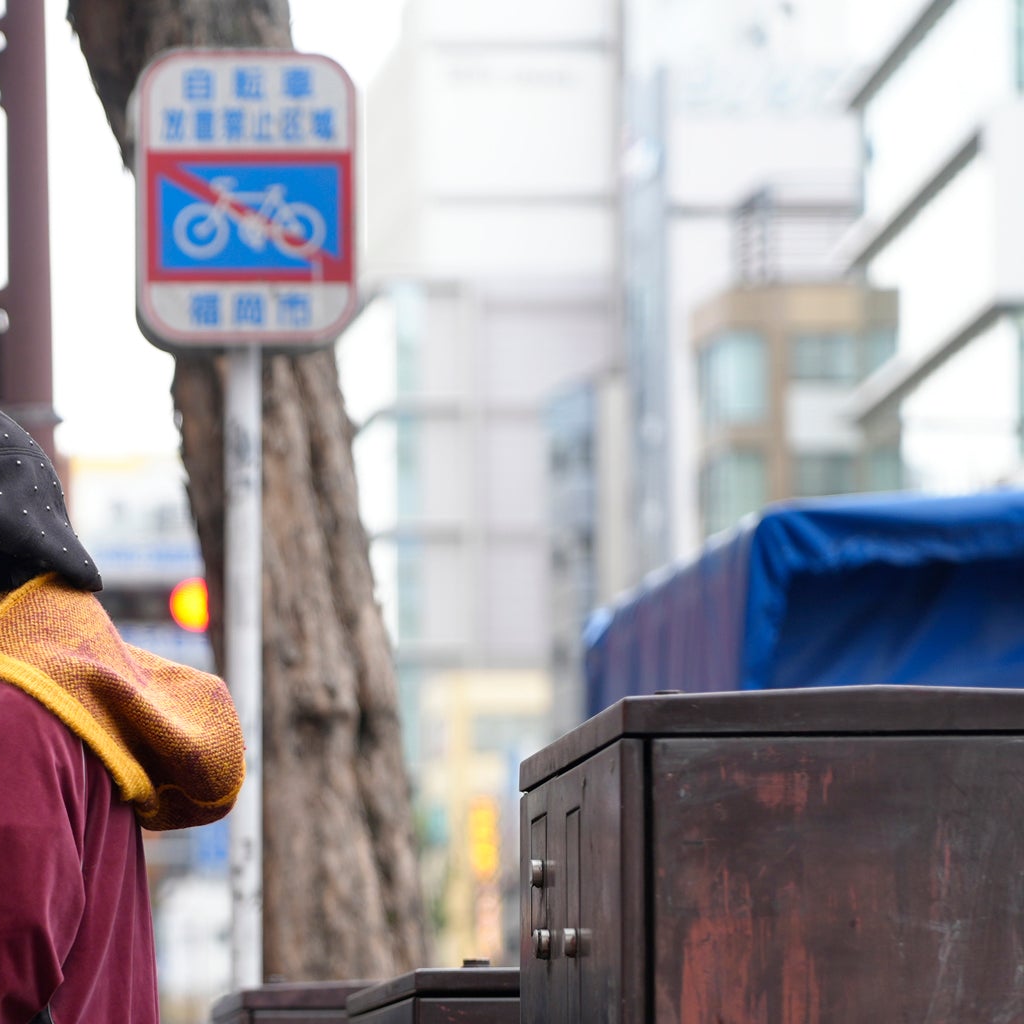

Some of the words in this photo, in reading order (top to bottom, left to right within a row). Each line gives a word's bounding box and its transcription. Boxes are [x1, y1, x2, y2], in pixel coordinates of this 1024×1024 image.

[184, 67, 312, 99] 自転車
[191, 294, 311, 325] 福岡市
